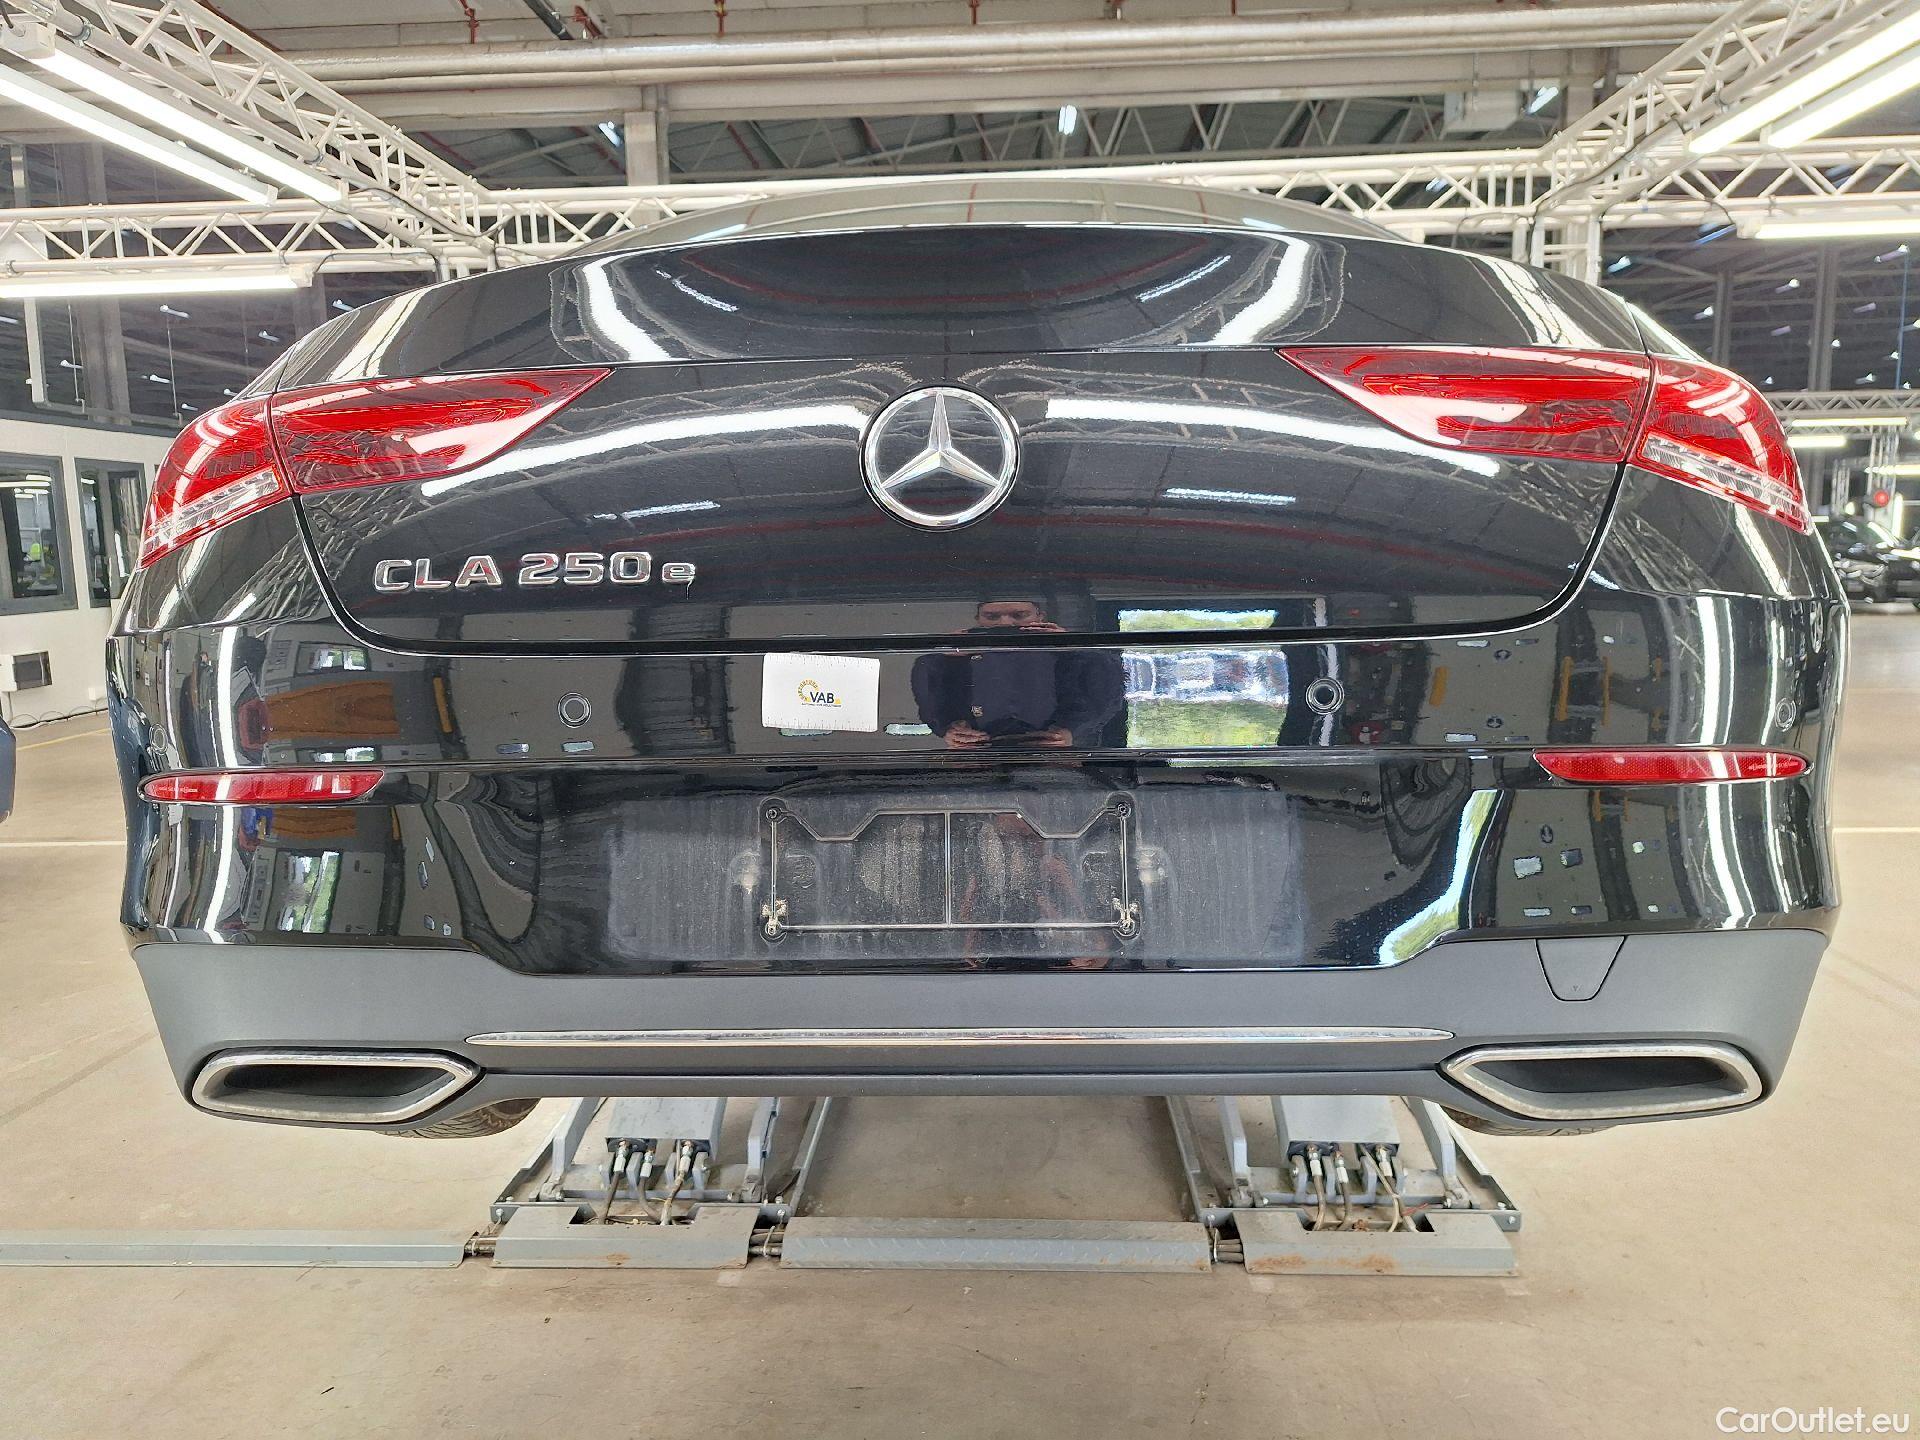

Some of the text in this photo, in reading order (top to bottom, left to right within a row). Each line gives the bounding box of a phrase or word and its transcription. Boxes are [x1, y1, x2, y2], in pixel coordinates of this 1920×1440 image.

[373, 551, 696, 590] CLA 250 e
[809, 691, 834, 703] VAB
